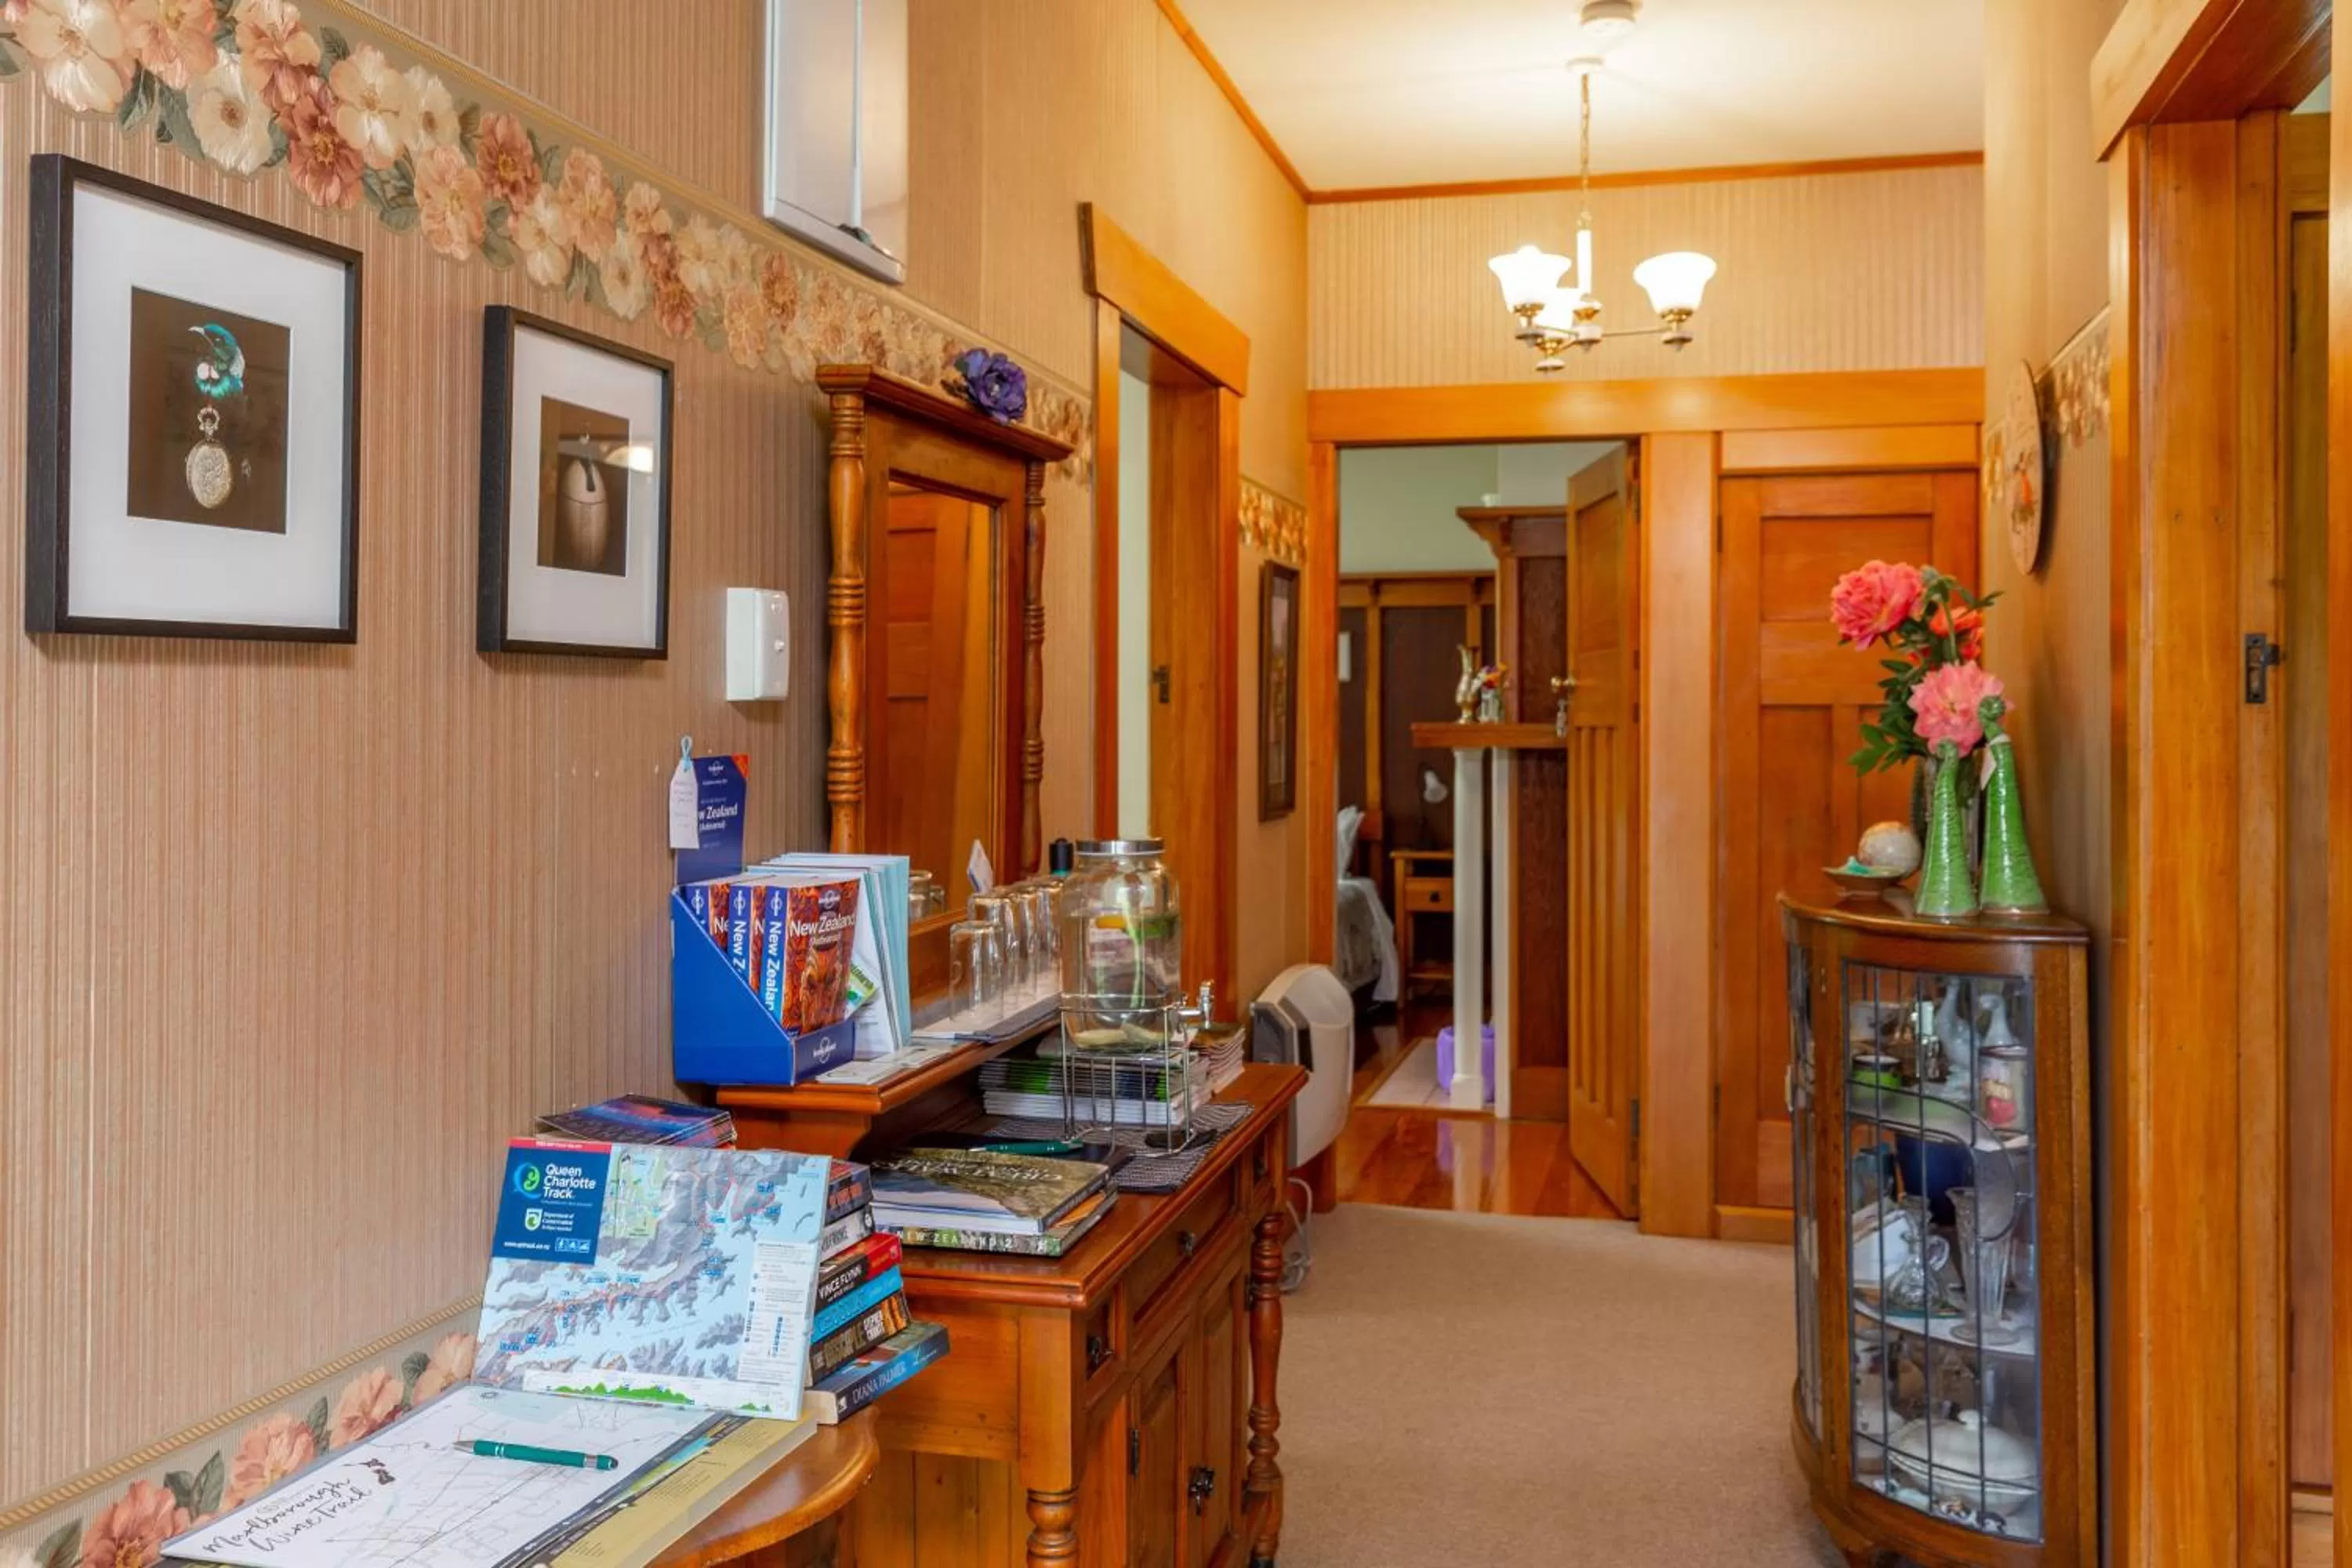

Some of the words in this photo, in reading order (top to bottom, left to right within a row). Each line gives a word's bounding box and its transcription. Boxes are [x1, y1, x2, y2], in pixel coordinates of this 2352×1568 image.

[706, 803, 738, 819] Zealand
[733, 920, 746, 956] New
[768, 921, 782, 956] New
[790, 920, 818, 938] New
[818, 913, 855, 934] Zealand
[765, 959, 780, 1011] Zealan
[544, 1176, 596, 1189] Charlotte
[546, 1163, 583, 1176] Queen
[543, 1187, 572, 1199] Track
[818, 1277, 840, 1299] VINCE
[840, 1264, 862, 1286] FLYNN
[853, 1379, 878, 1403] DIANA
[878, 1361, 906, 1387] PALMER
[202, 1479, 351, 1553] Marlborough
[249, 1513, 321, 1552] Wine
[311, 1486, 372, 1518] Trail
